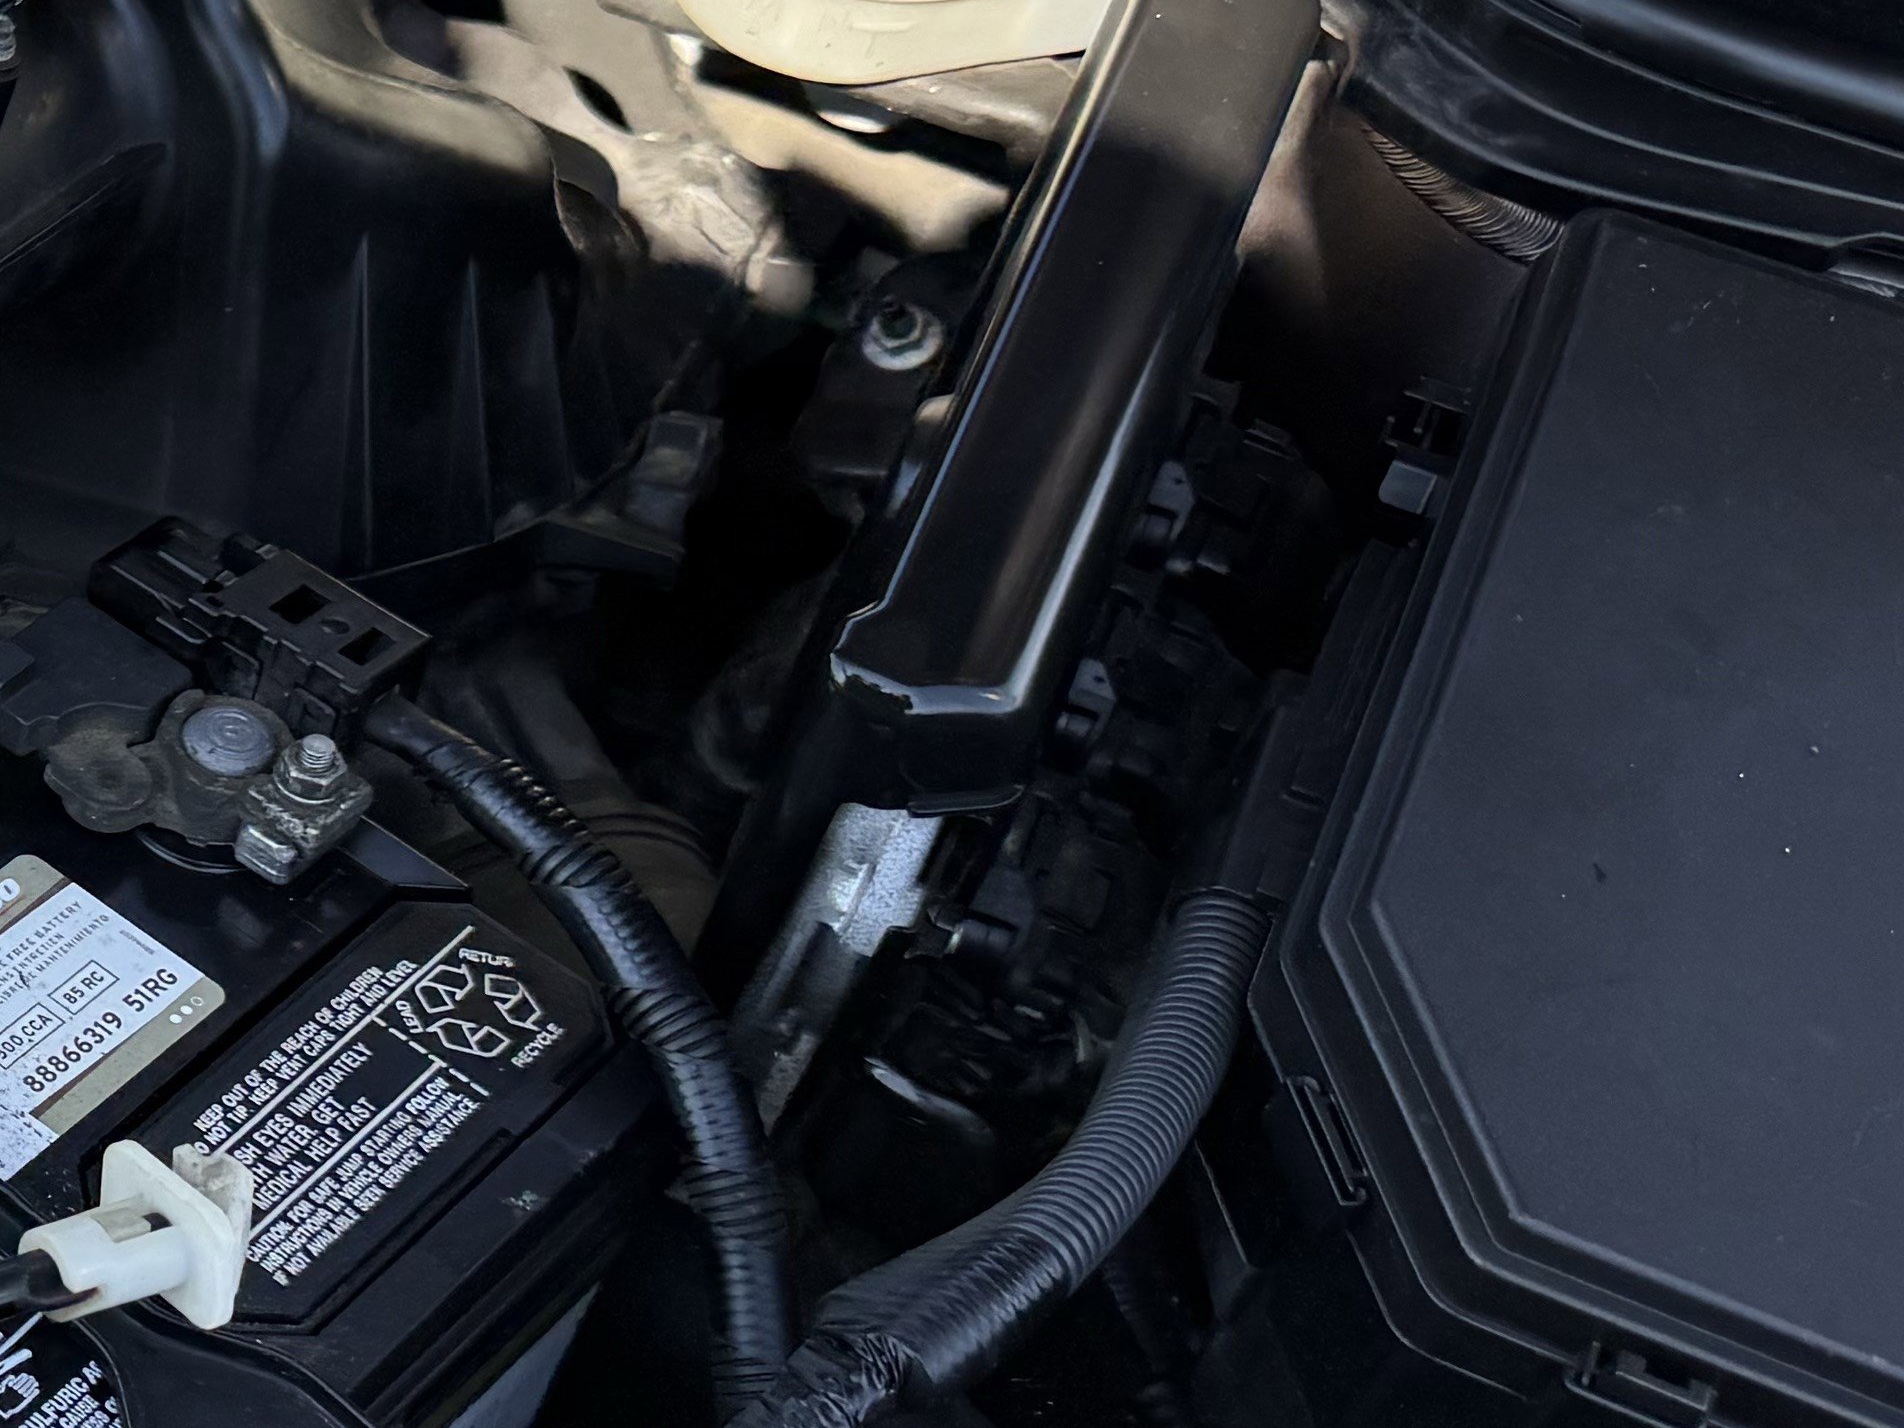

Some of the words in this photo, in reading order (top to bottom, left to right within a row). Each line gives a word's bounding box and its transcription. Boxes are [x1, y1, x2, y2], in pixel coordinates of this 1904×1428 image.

[21, 1013, 53, 1039] CCA
[24, 1011, 125, 1094] 88866319
[125, 968, 179, 1013] 51RG
[83, 971, 106, 990] RC
[395, 999, 427, 1033] LEAD
[195, 1106, 227, 1132] KEEP
[220, 1085, 248, 1108] OUT
[244, 1071, 265, 1088] OF
[260, 1051, 288, 1075] THE
[283, 1021, 322, 1055] REACH
[316, 1008, 337, 1024] OF
[204, 1122, 233, 1146] NOT
[250, 1079, 282, 1106] KEEP
[277, 1056, 309, 1082] VENT
[304, 1033, 335, 1059] CAPS
[330, 1003, 367, 1035] TIGHT
[362, 986, 387, 1007] AND
[254, 1111, 296, 1147] EYES
[287, 1042, 374, 1117] IMMEDIATELY
[310, 1097, 345, 1127] GET
[250, 1156, 313, 1210] MEDICAL
[304, 1127, 345, 1162] HELP
[336, 1098, 377, 1132] FAST
[287, 1200, 314, 1224] FOR
[309, 1178, 338, 1203] SAFE
[333, 1154, 366, 1181] JUMP
[360, 1112, 413, 1158] STARTING
[406, 1078, 450, 1116] FOLLOW
[261, 1210, 335, 1275] INSTRUCTIONS
[341, 1163, 386, 1203] VEHICLE
[285, 1254, 313, 1278] NOT
[308, 1208, 362, 1257] AVAILABLE
[356, 1187, 386, 1212] SEEK
[380, 1149, 426, 1189] SERVICE
